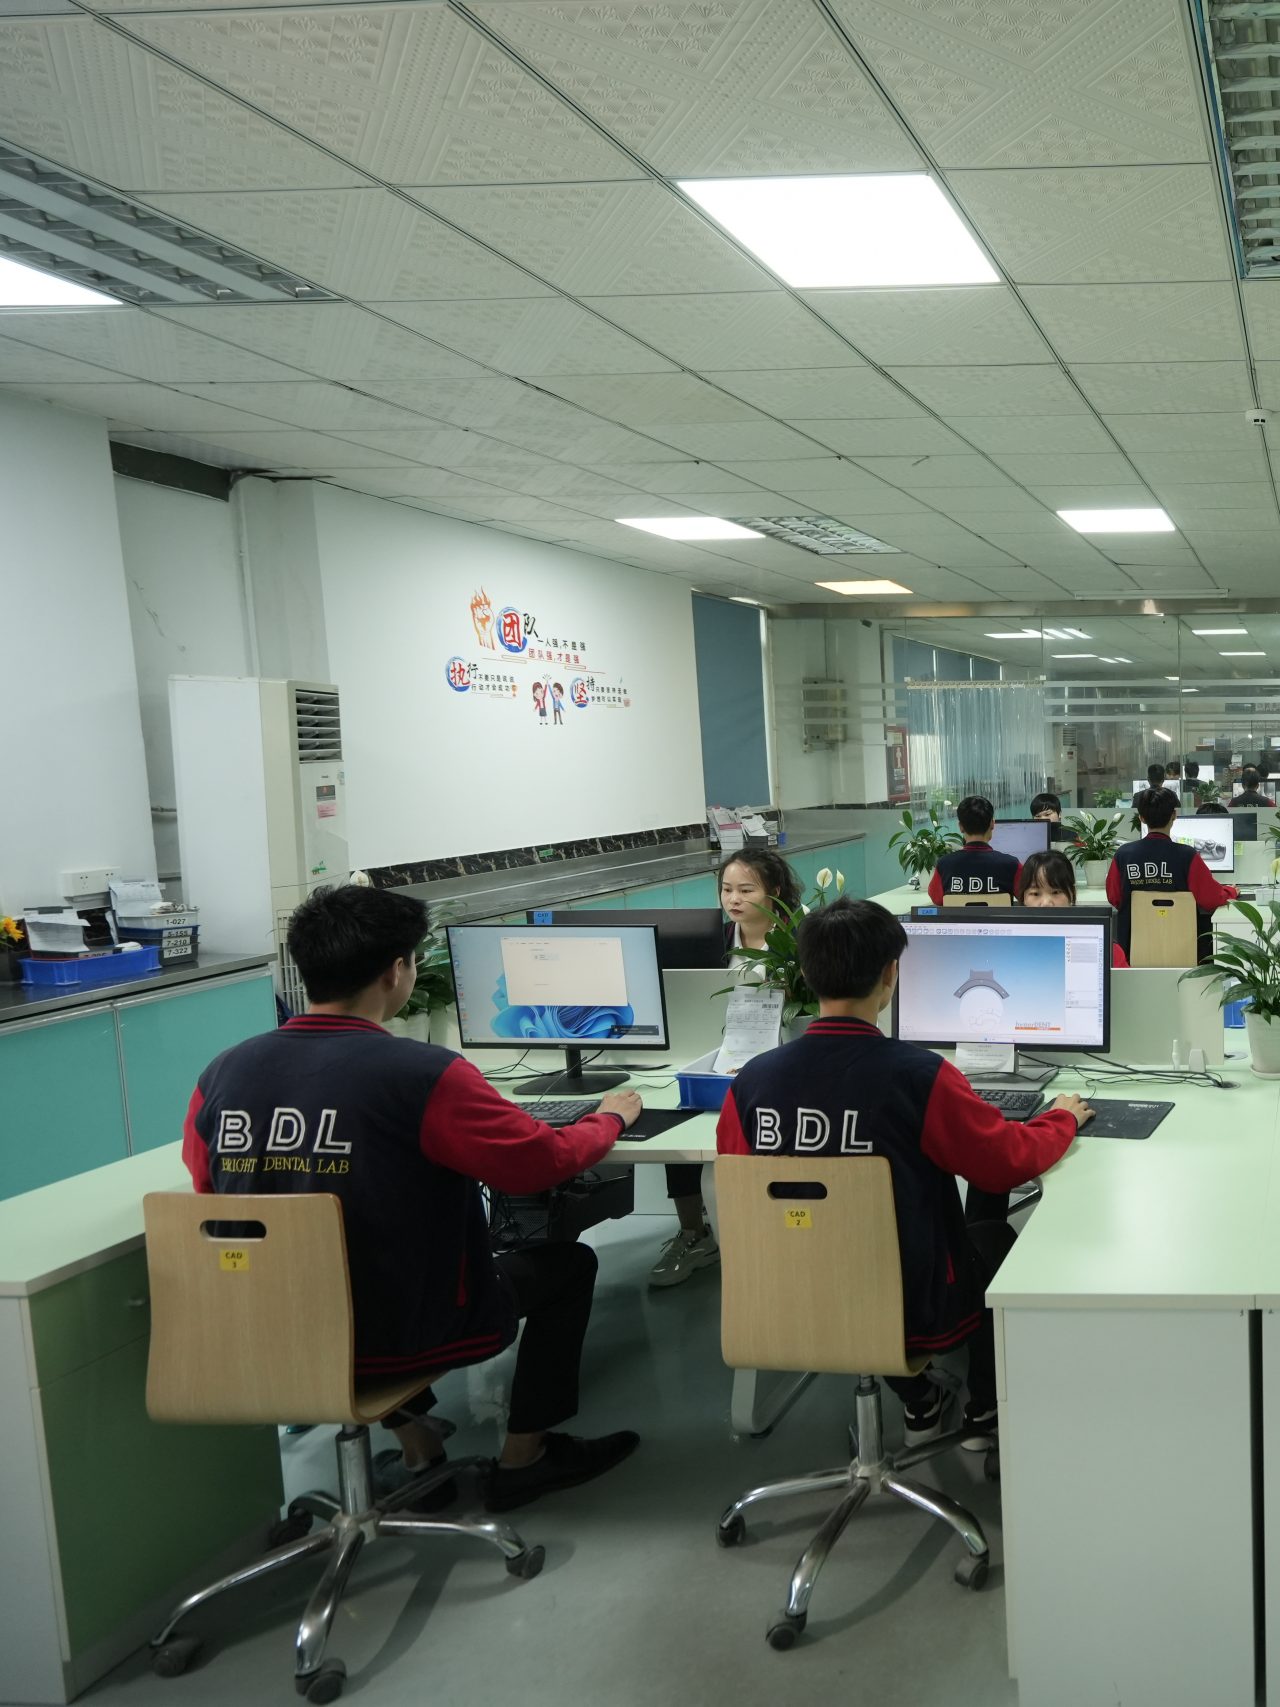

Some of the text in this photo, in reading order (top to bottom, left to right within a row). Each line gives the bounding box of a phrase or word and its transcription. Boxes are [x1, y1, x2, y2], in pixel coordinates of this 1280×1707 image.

[502, 612, 539, 649] 团队
[450, 661, 479, 686] 执行
[574, 676, 595, 704] 坚持
[1126, 862, 1173, 879] BDL
[950, 876, 1000, 892] BDL
[166, 918, 186, 926] 1-027
[167, 948, 188, 956] 7-322
[217, 1107, 352, 1154] BDL
[756, 1107, 873, 1153] BDL
[221, 1156, 349, 1174] BRIGHT DENTAL LAB
[225, 1251, 243, 1259] CAD
